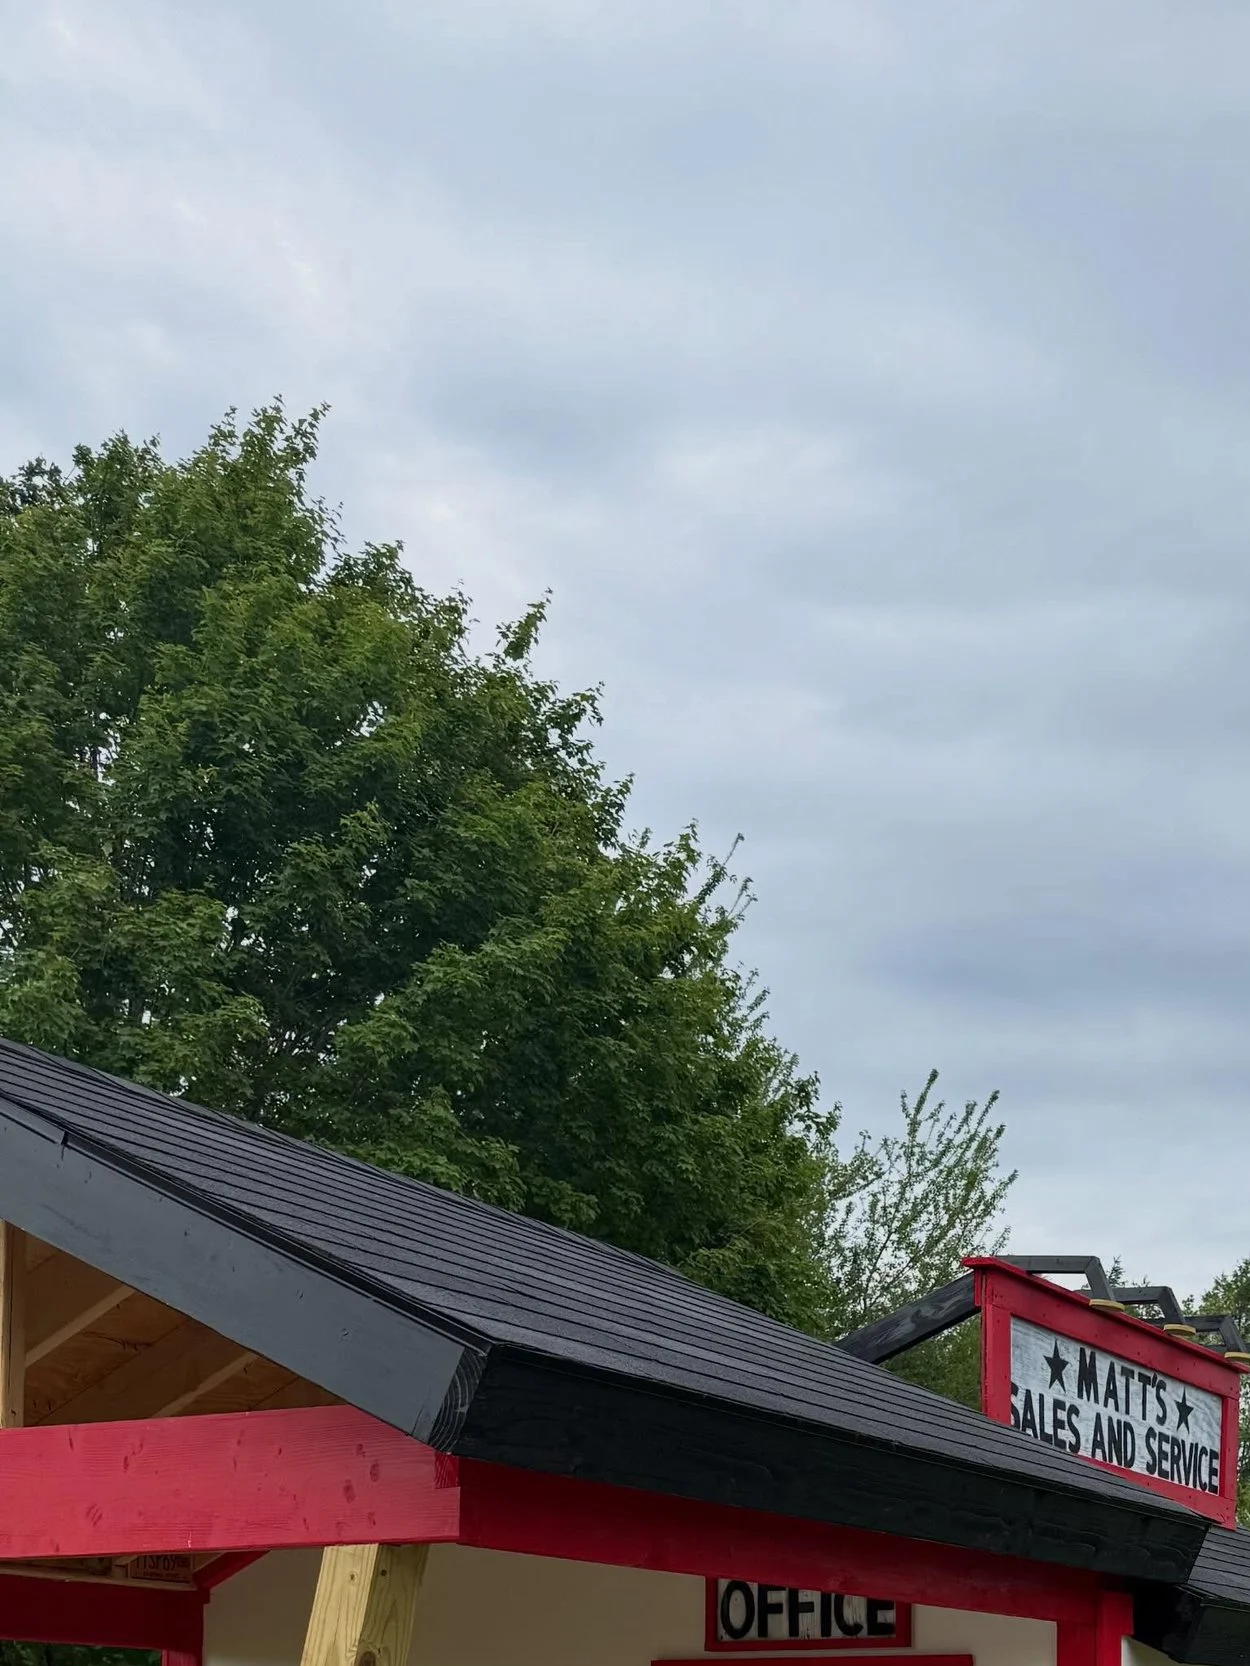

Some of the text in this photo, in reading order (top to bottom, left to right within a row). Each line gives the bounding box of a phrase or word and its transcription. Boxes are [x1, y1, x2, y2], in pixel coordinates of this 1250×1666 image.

[1077, 1347, 1167, 1427] MATT'S
[1010, 1382, 1219, 1496] SALES AND SERVICE
[720, 1579, 896, 1640] OFFICE
